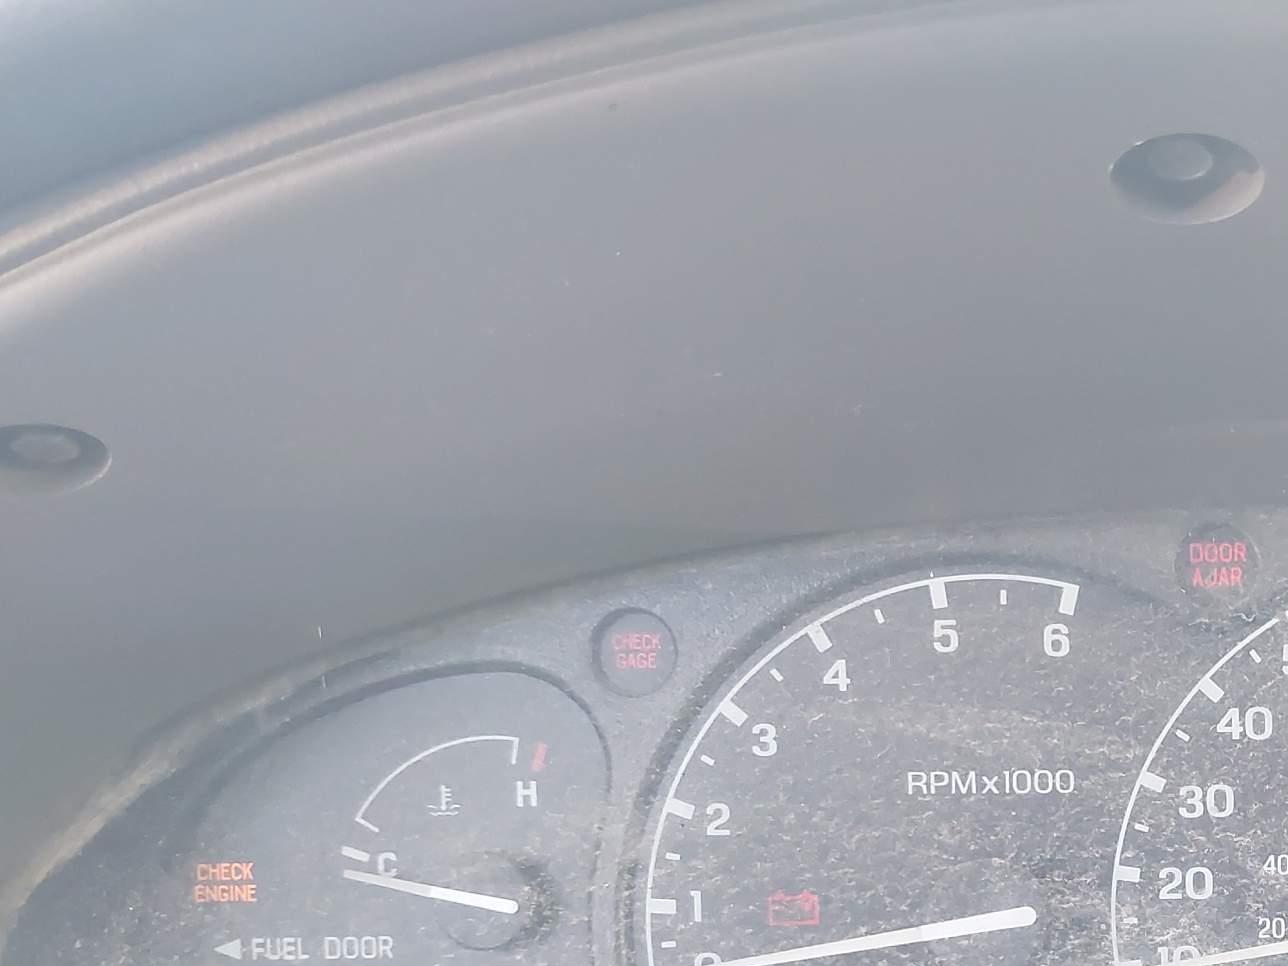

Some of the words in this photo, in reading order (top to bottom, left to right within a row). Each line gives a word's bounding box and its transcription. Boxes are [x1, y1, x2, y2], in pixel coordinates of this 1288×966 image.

[1189, 543, 1247, 562] DOOR
[1191, 568, 1243, 587] AJAR
[612, 632, 662, 650] CHECK
[932, 620, 959, 653] 5
[1043, 624, 1071, 657] 6
[616, 653, 657, 669] GAGE
[823, 659, 851, 692] 4
[1216, 706, 1274, 740] 40
[751, 724, 778, 757] 3
[516, 780, 538, 807] H
[1178, 784, 1235, 818] 30
[705, 803, 731, 836] 2
[196, 862, 254, 881] CHECK
[376, 853, 399, 877] C
[194, 885, 257, 902] ENGINE
[1158, 866, 1214, 900] 20
[689, 890, 702, 921] 1
[1258, 917, 1286, 939] 20
[252, 938, 310, 960] FUEL
[324, 936, 394, 960] DOOR
